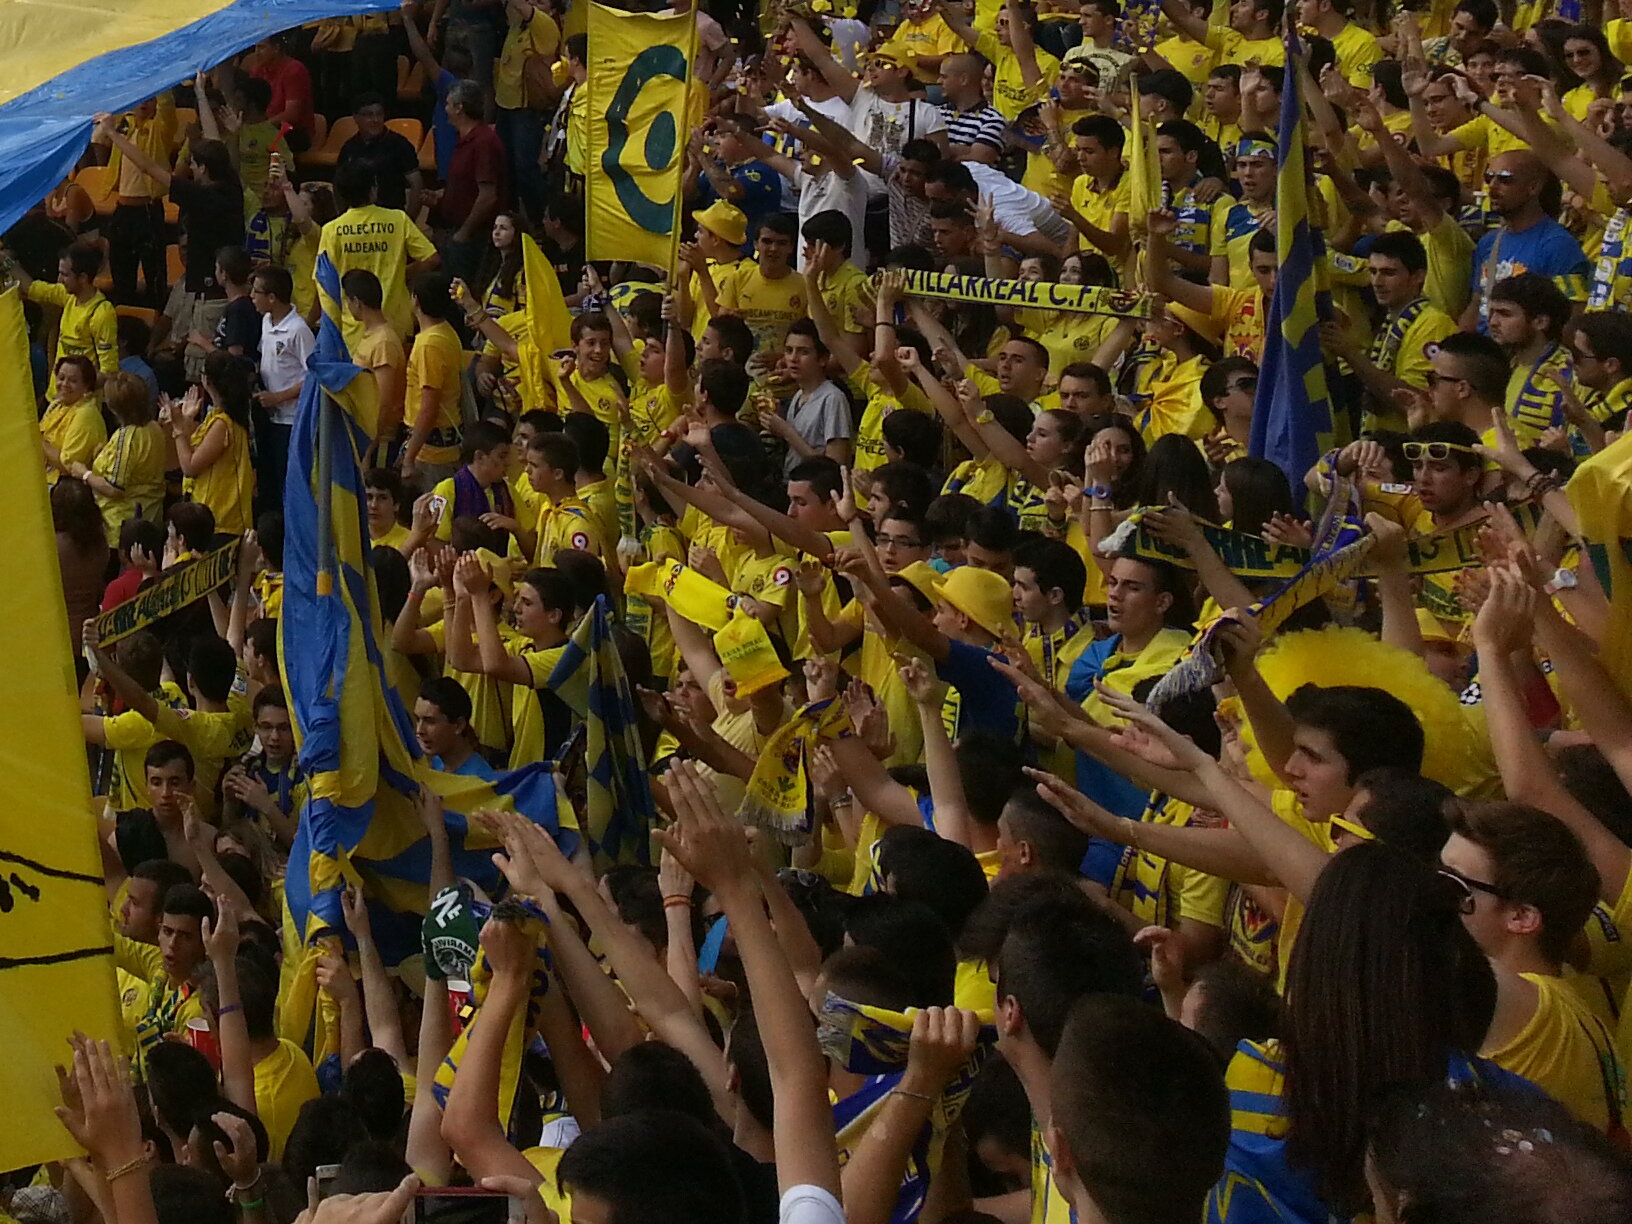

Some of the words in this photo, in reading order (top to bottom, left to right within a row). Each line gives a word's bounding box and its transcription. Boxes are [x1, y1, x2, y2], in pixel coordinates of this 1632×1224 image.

[336, 223, 395, 236] COLECTIVO
[343, 241, 389, 255] ALDEANO
[906, 268, 1040, 304] VILLARREAL
[1048, 284, 1097, 309] C.F.
